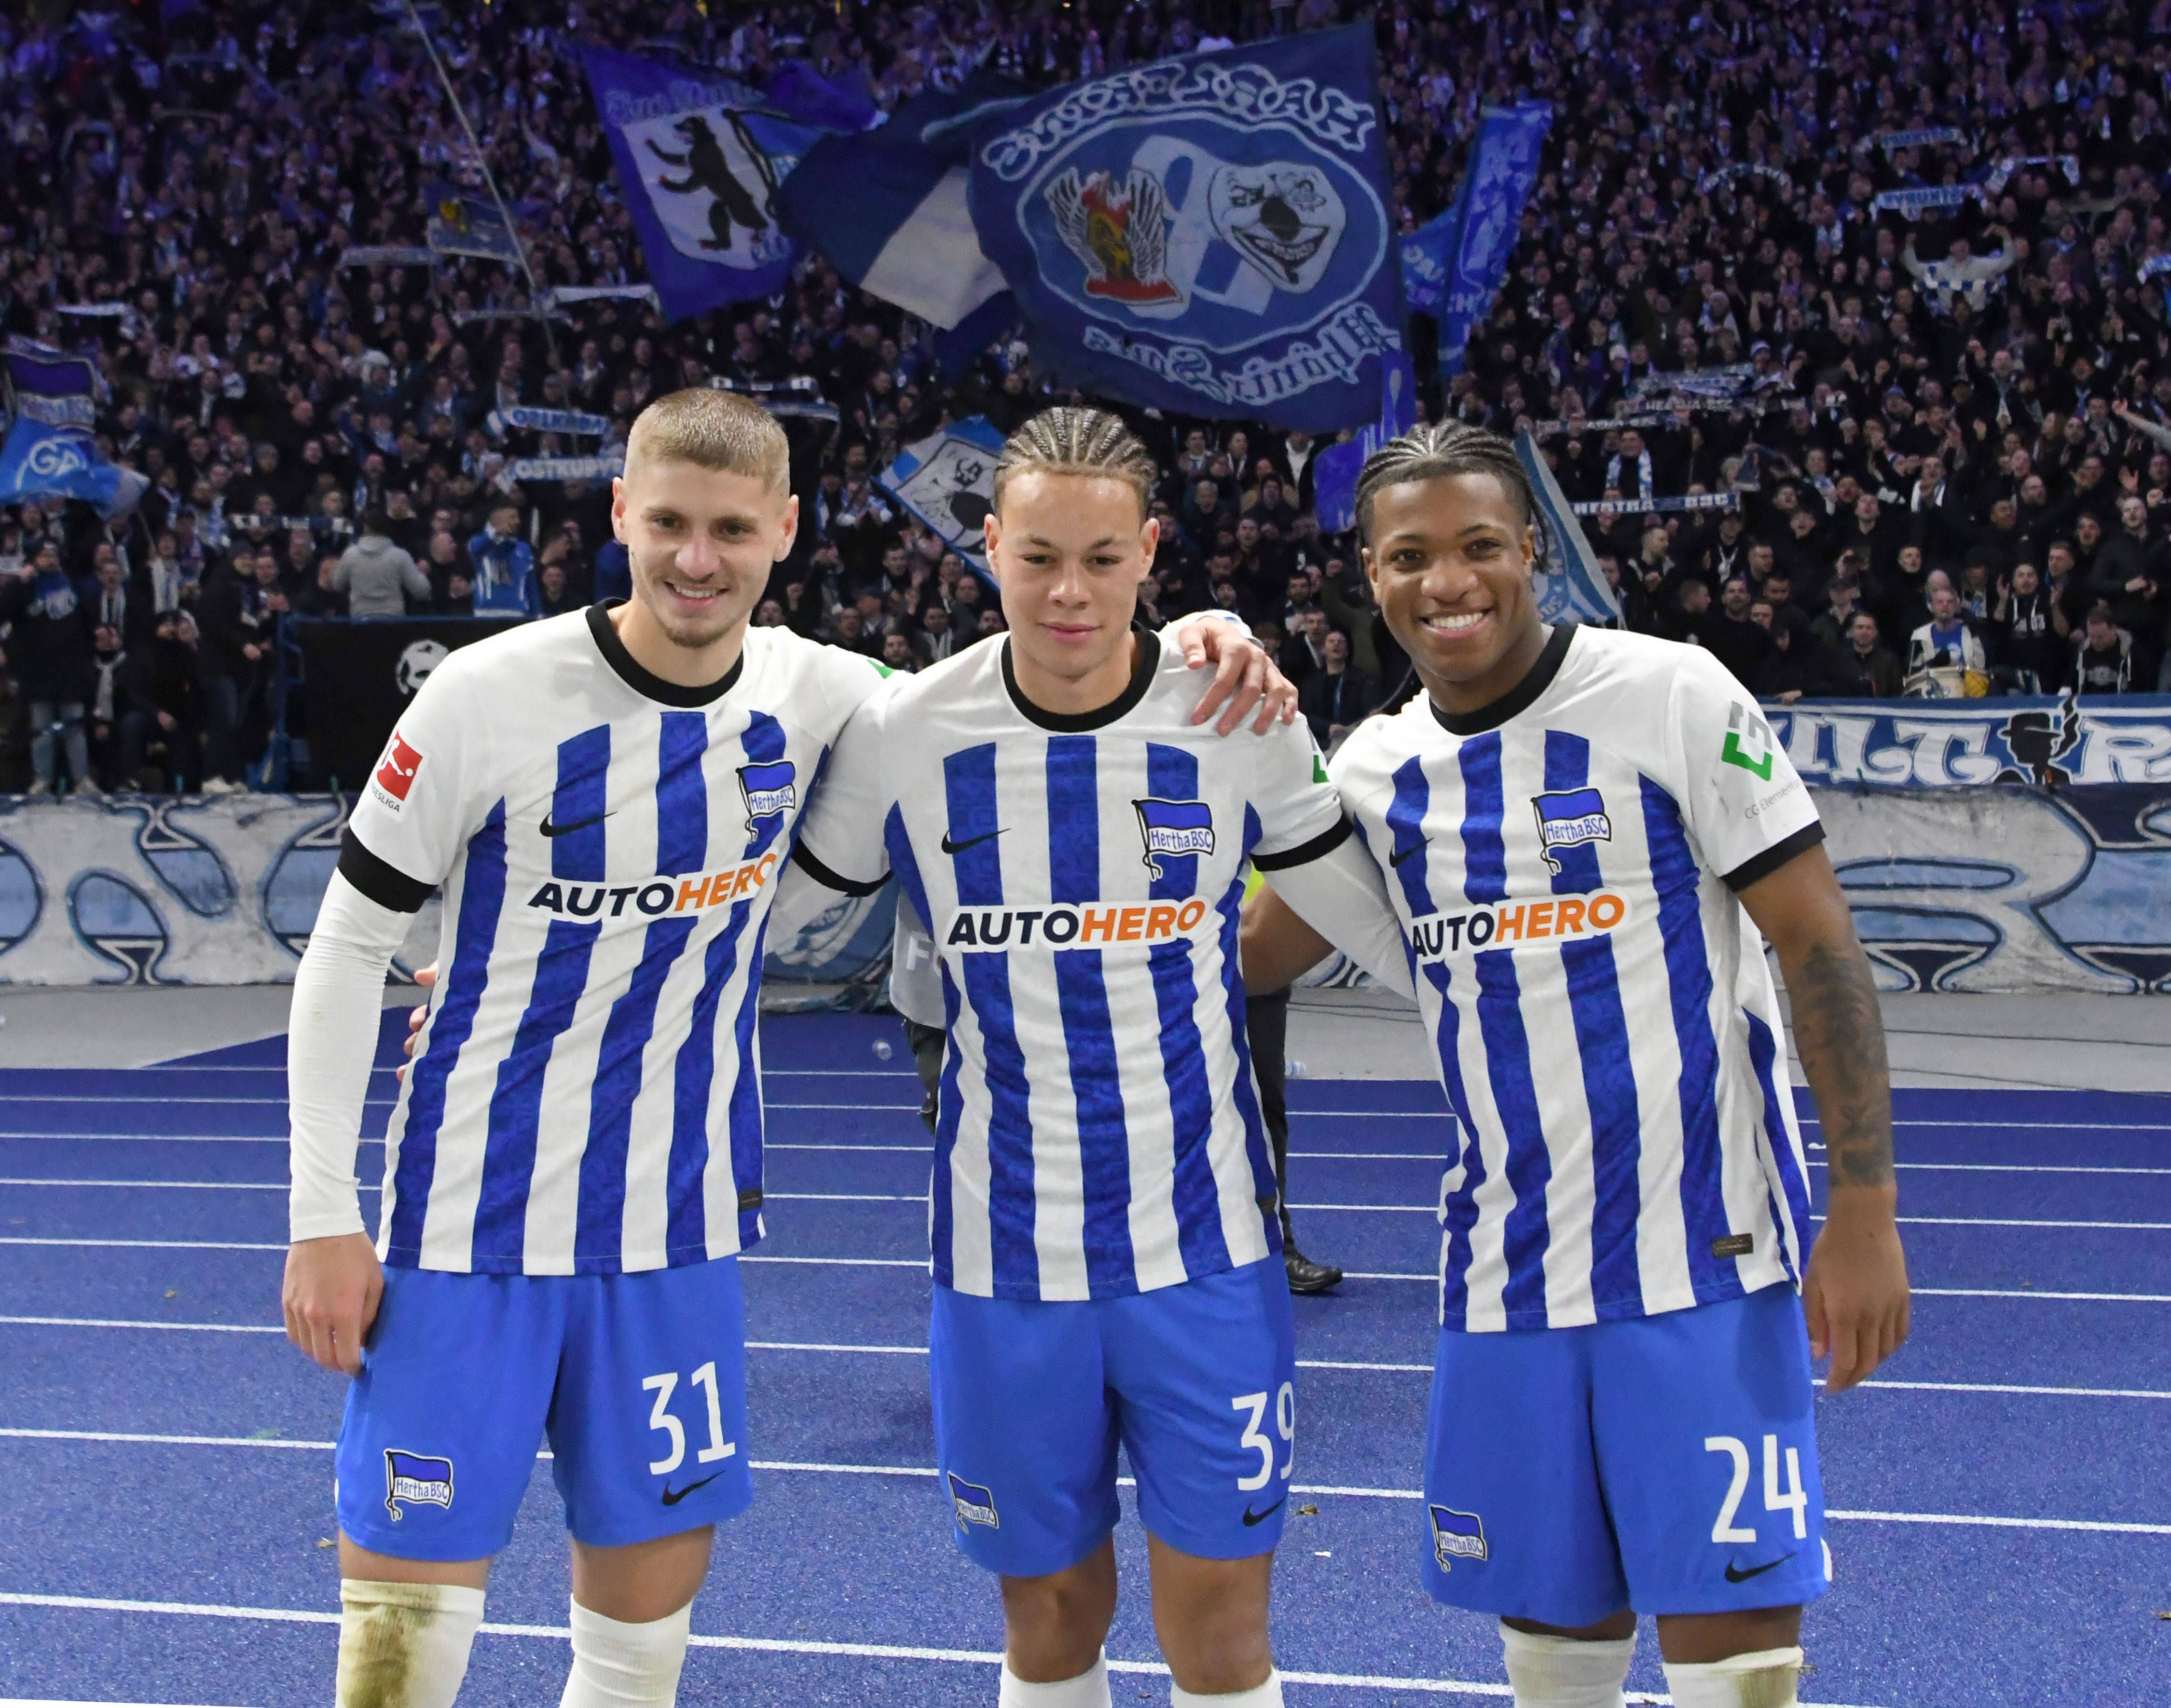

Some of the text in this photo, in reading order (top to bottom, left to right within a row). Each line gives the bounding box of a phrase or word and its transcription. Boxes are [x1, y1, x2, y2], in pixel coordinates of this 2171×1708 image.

[527, 853, 777, 917] AUTOHERO
[947, 900, 1205, 946] AUTOHERO
[1413, 895, 1625, 958] AUTOHERO
[642, 1361, 736, 1475] 31
[1232, 1381, 1295, 1491] 39
[1704, 1434, 1807, 1543] 24
